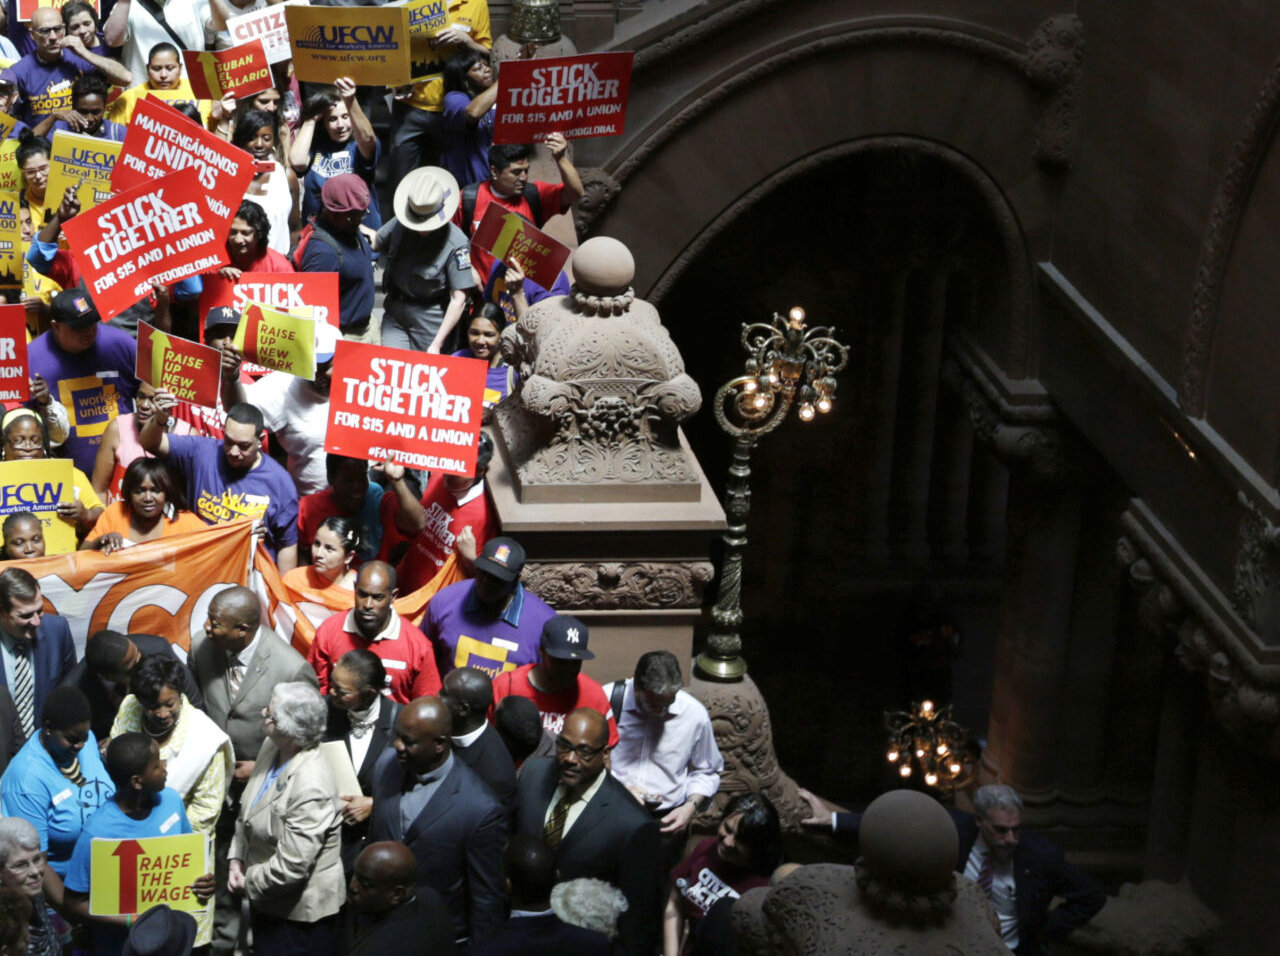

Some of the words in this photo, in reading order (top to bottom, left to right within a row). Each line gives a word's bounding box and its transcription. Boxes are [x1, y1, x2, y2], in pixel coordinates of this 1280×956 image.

[318, 25, 396, 44] UFCW
[217, 53, 254, 73] SUBAN
[311, 52, 387, 64] www.ufcw.org
[221, 68, 269, 90] SALARIO
[531, 62, 600, 89] STICK
[507, 79, 620, 107] TOGETHER
[135, 112, 240, 178] MANTENGÁMONOS
[97, 188, 176, 239] STICK
[83, 201, 204, 270] TOGETHER
[93, 273, 118, 295] FOR
[118, 261, 137, 280] $15
[137, 246, 164, 268] AND
[165, 243, 177, 258] A
[176, 228, 216, 254] UNION
[260, 324, 296, 341] RAISE
[164, 350, 205, 371] RAISE
[368, 357, 449, 396] STICK
[342, 377, 472, 424] TOGETHER
[334, 410, 360, 430] FOR
[362, 416, 384, 434] $15
[386, 421, 417, 441] AND
[418, 426, 429, 442] A
[430, 428, 475, 447] UNION
[368, 447, 468, 474] #FASTFOODGLOBAL
[139, 852, 192, 872] RAISE
[139, 871, 174, 887] THE
[139, 885, 192, 903] WAGE
